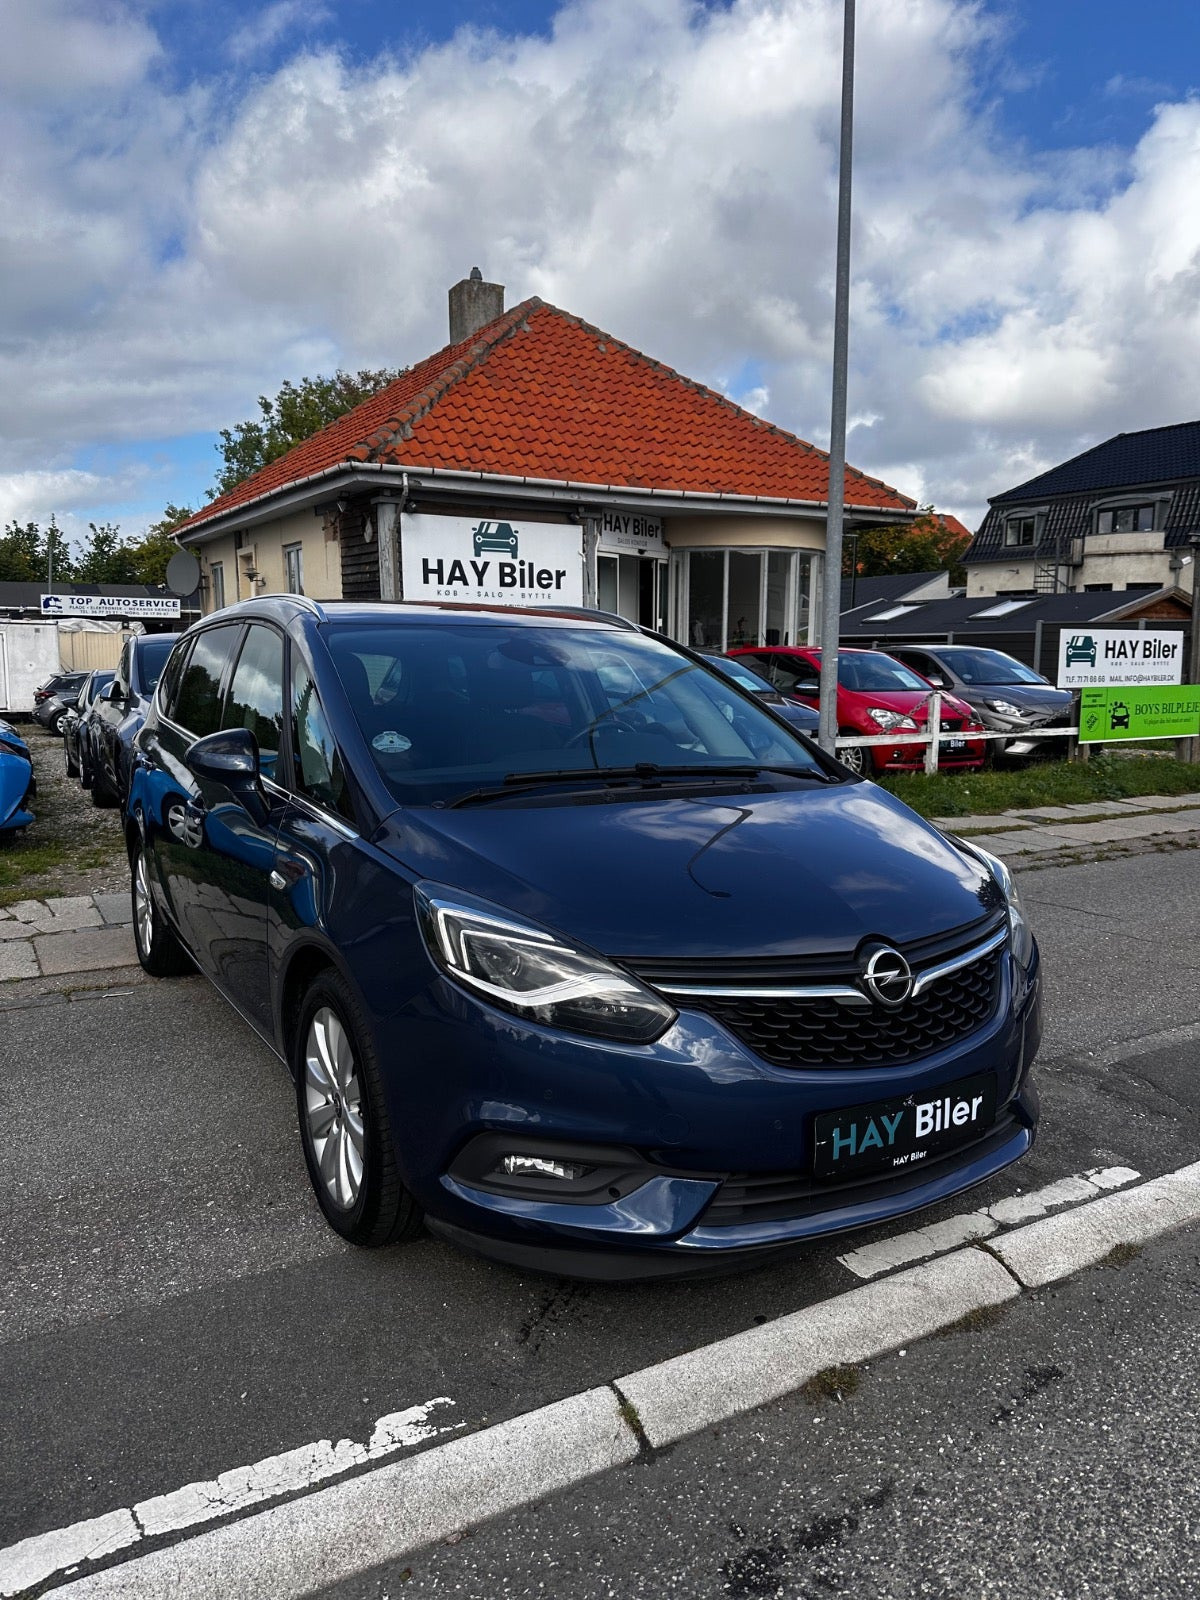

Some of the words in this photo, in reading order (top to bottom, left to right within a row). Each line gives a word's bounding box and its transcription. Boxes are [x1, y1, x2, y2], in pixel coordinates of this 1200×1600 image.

[603, 513, 630, 534] HAY
[633, 516, 660, 538] Biler
[422, 558, 490, 587] HAY
[498, 560, 566, 589] Biler
[69, 597, 92, 605] TOP
[99, 598, 178, 608] AUTOSERVICE
[436, 589, 458, 597] KØB
[521, 592, 552, 600] BYTTE
[1104, 640, 1139, 659] HAY
[1143, 638, 1178, 659] Biler
[1135, 703, 1160, 715] BOYS
[1162, 702, 1200, 714] BILPLEJE
[832, 1111, 904, 1161] HAY
[915, 1095, 983, 1138] Biler
[893, 1154, 909, 1166] HAY
[910, 1150, 927, 1161] Biler
